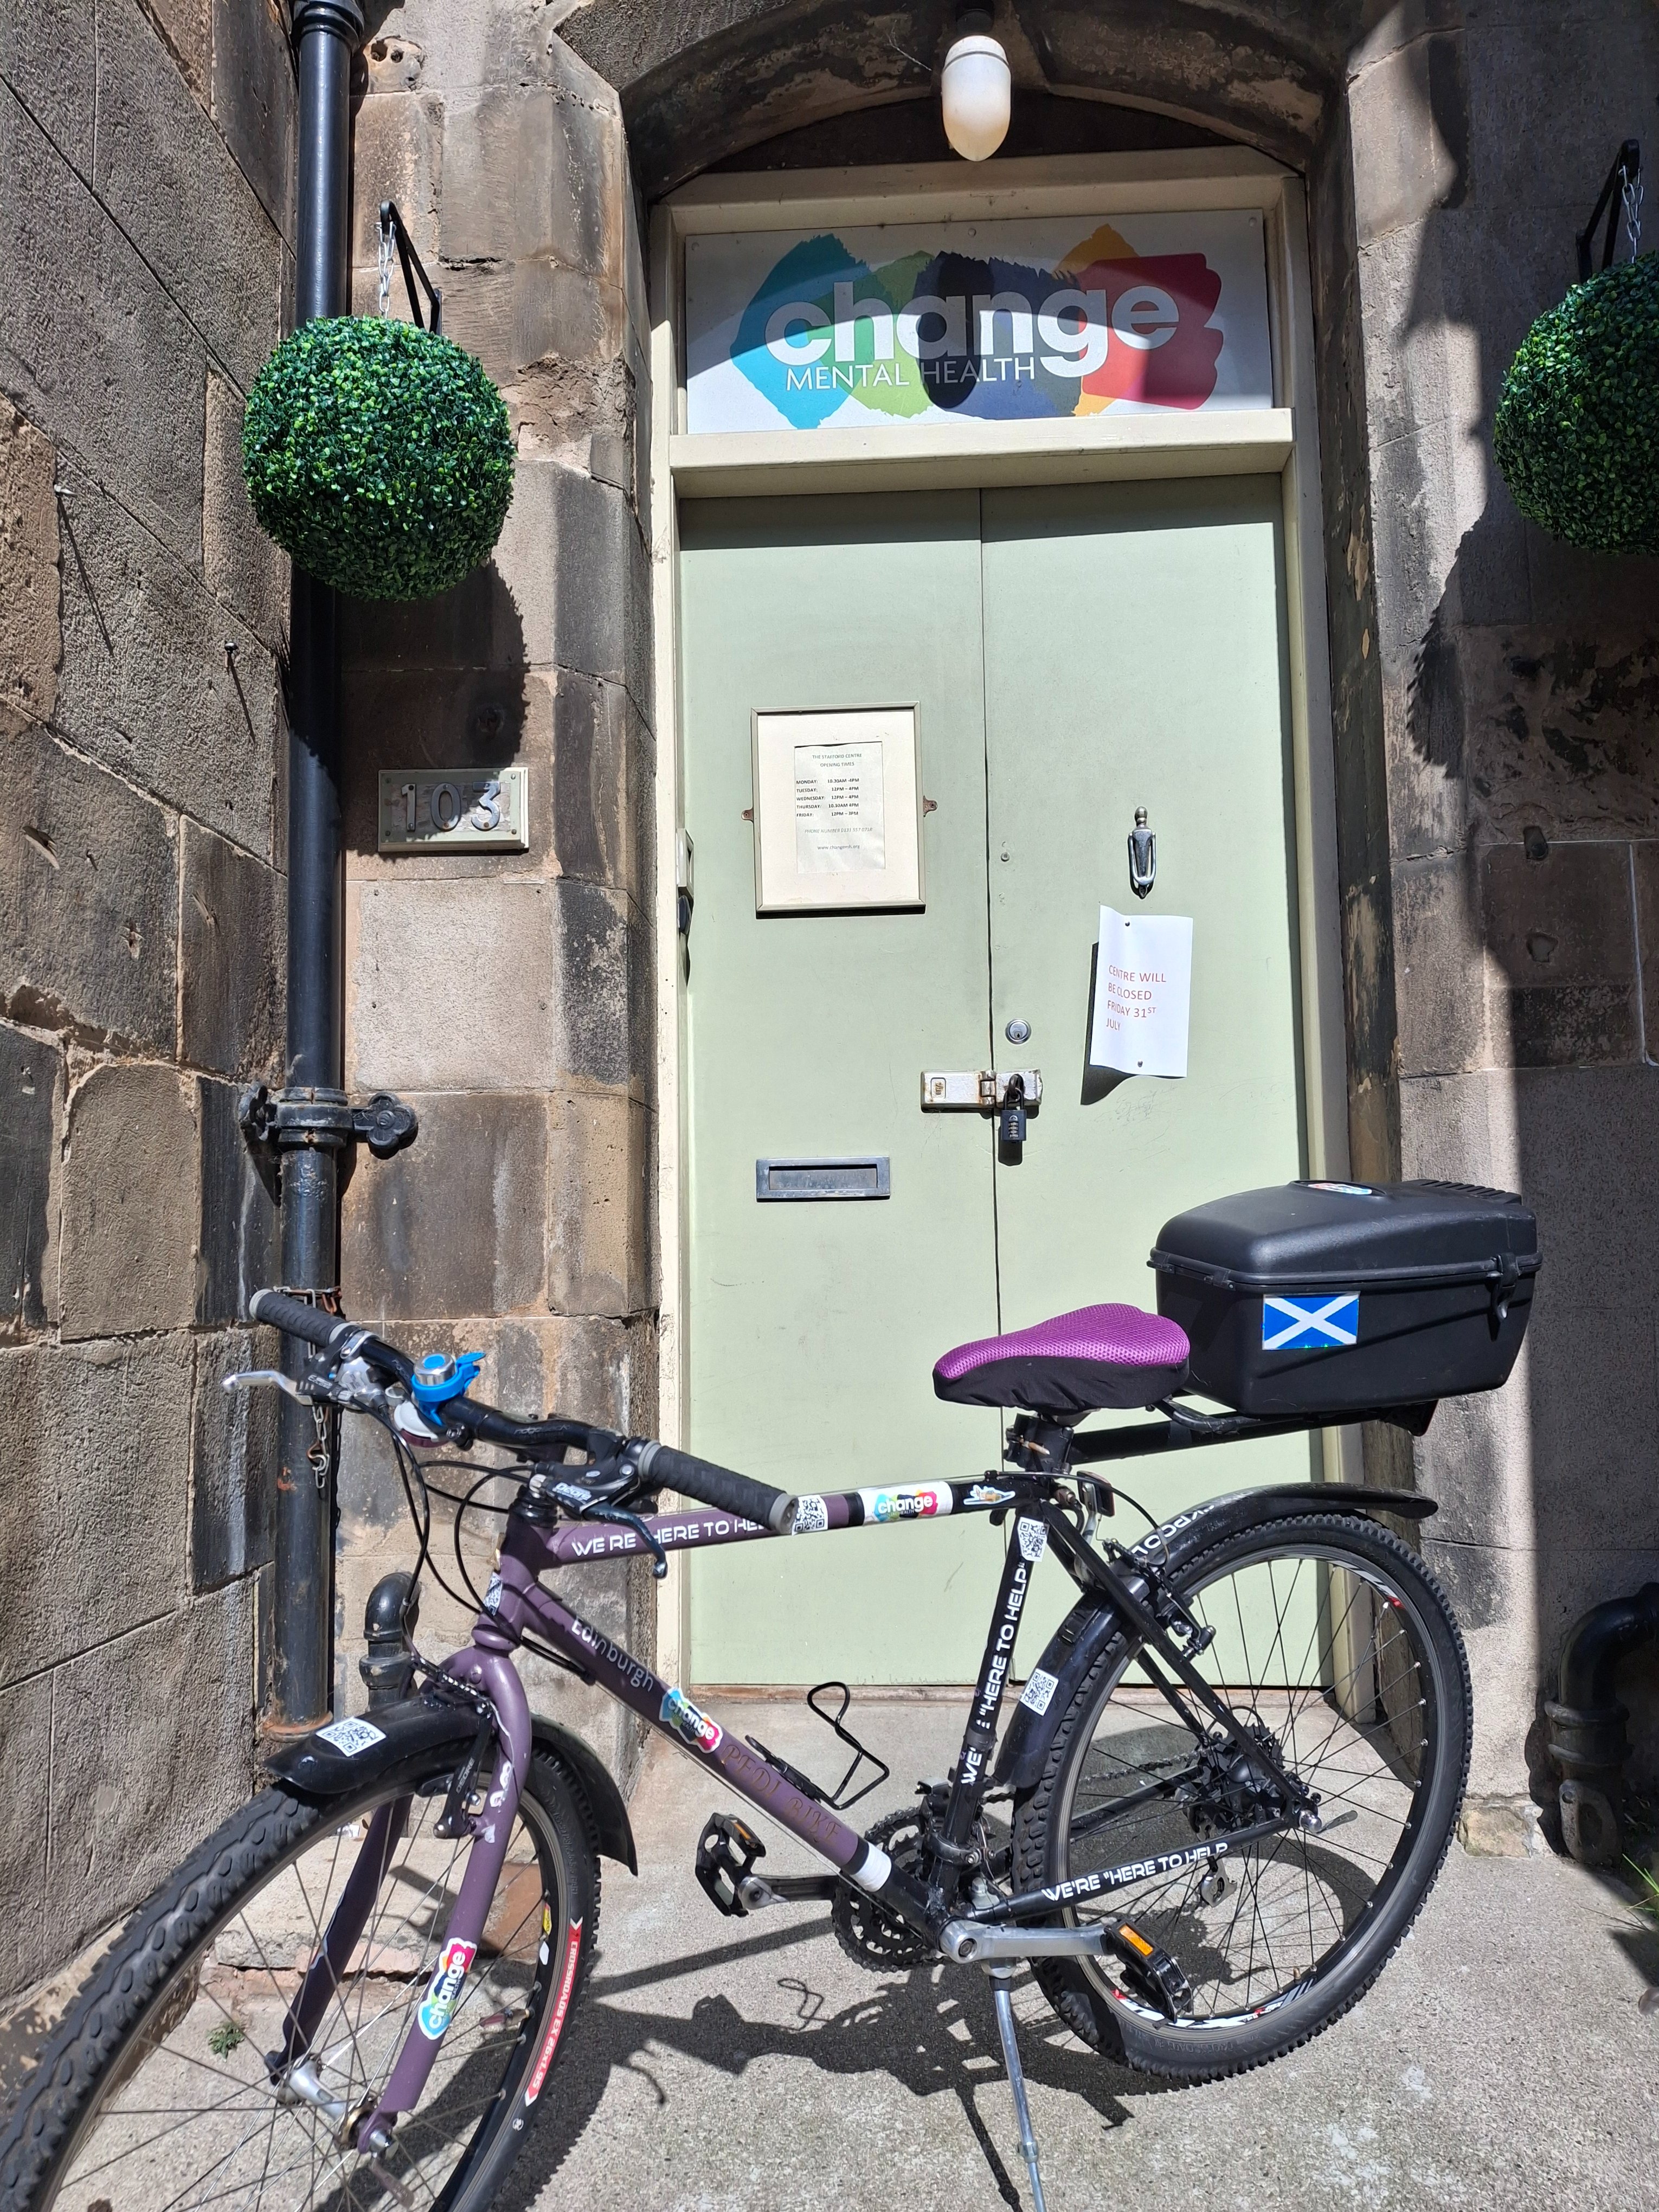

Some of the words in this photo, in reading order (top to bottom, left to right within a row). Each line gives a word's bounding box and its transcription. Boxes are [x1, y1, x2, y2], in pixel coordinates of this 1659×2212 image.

[765, 281, 1180, 378] change
[786, 363, 910, 391] MENTAL
[921, 357, 1035, 384] HEALTH
[401, 781, 501, 832] 103
[1108, 964, 1135, 982] CENTRE
[1139, 972, 1167, 982] WILL
[1108, 982, 1116, 994] BE
[1117, 986, 1152, 1000] CLOSED
[1107, 1000, 1130, 1017] FRIDAY
[1133, 1007, 1157, 1018] 31ST
[1106, 1018, 1121, 1031] JULY
[877, 1495, 934, 1514] change
[703, 1520, 730, 1537] TO
[996, 1624, 1015, 1652] TO
[571, 1615, 654, 1692] Edinburgh
[667, 1697, 716, 1741] change
[455, 1756, 475, 1795] DEORE
[1157, 1854, 1183, 1870] TO
[1185, 1842, 1229, 1865] HELP
[429, 1951, 466, 2029] change
[556, 1940, 578, 2018] CROSSROADS
[550, 2020, 562, 2035] EX
